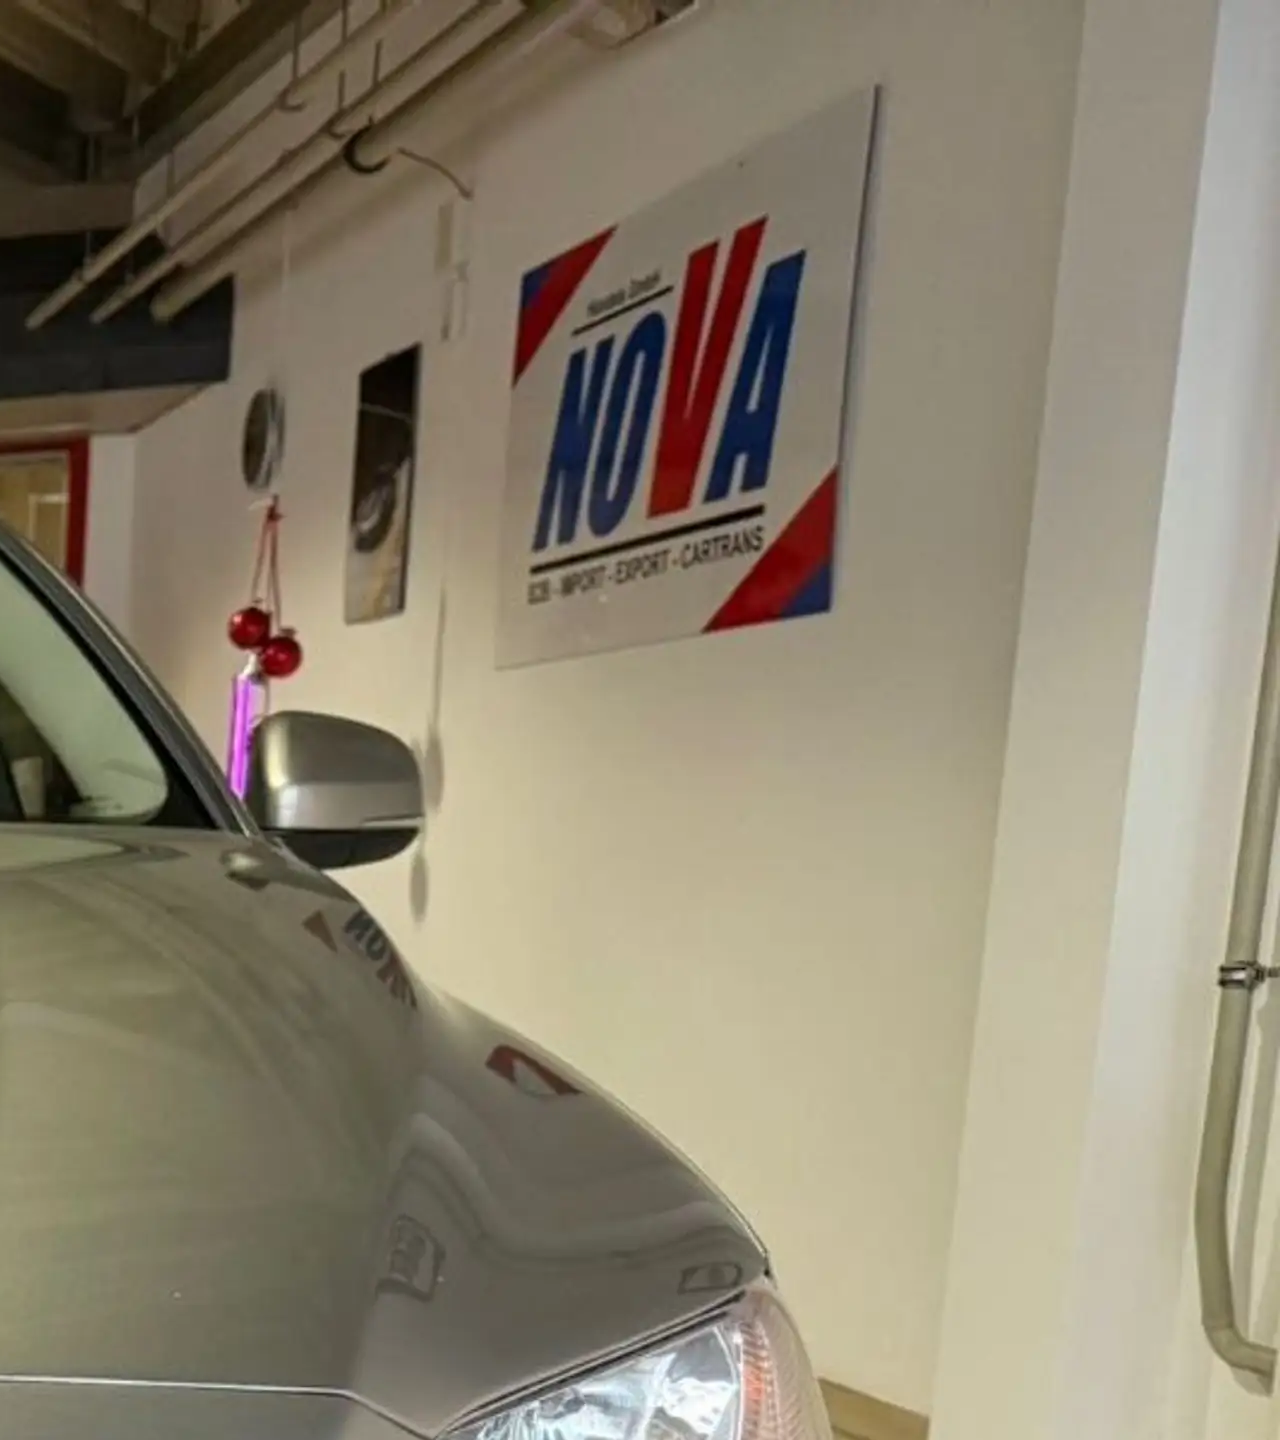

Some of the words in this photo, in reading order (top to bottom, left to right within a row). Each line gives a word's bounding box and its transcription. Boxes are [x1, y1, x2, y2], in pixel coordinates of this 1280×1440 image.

[530, 215, 808, 554] NOVA
[616, 548, 672, 585] EXPORT
[678, 524, 767, 571] CARTRANS
